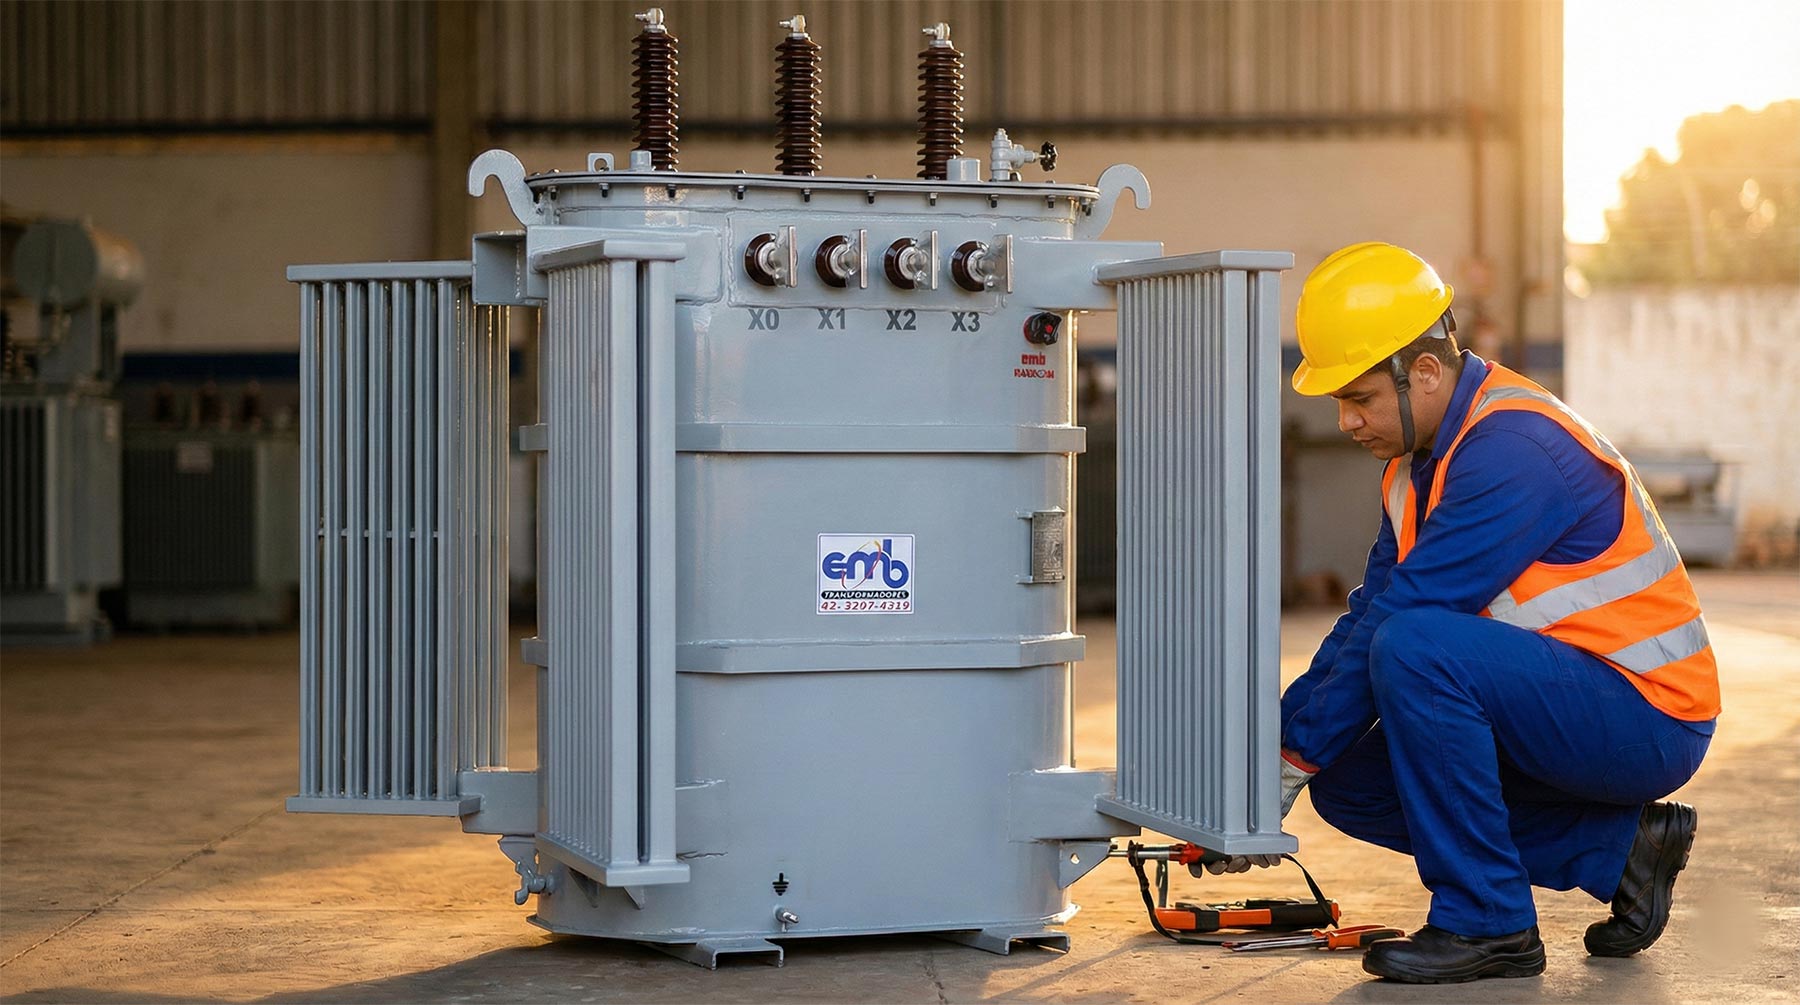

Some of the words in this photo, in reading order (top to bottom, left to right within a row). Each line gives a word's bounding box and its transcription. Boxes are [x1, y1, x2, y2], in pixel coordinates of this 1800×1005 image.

[748, 309, 780, 330] X0
[817, 308, 846, 330] X1
[886, 309, 917, 331] X2
[951, 311, 980, 332] X3
[1021, 353, 1046, 366] emb
[822, 539, 909, 589] emb
[844, 601, 910, 610] 3207-4319
